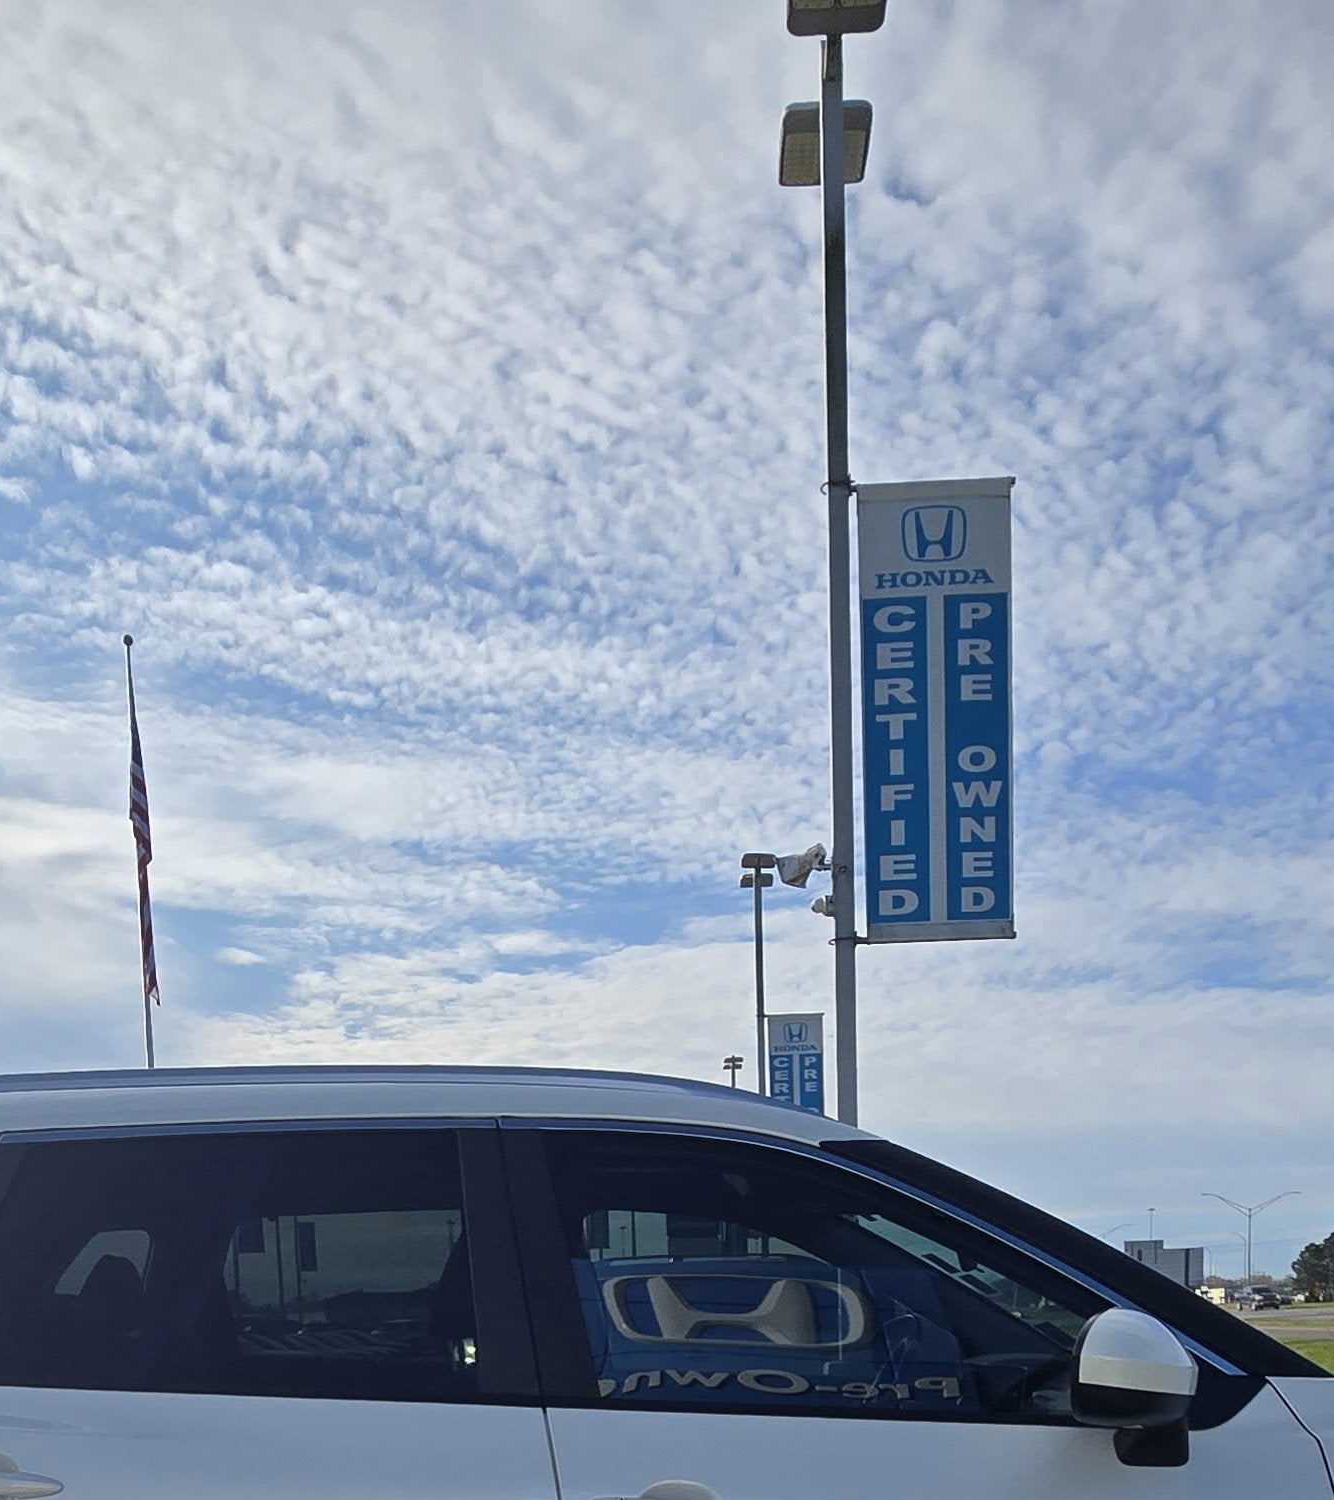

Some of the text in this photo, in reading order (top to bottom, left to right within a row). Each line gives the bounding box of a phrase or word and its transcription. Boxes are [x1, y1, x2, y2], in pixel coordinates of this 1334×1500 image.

[874, 568, 994, 589] HONDA
[872, 604, 919, 917] CERTIFIED
[952, 601, 1003, 914] PRE OWNED
[773, 1044, 819, 1052] HONDA
[773, 1056, 791, 1100] CER
[803, 1056, 818, 1093] PRE
